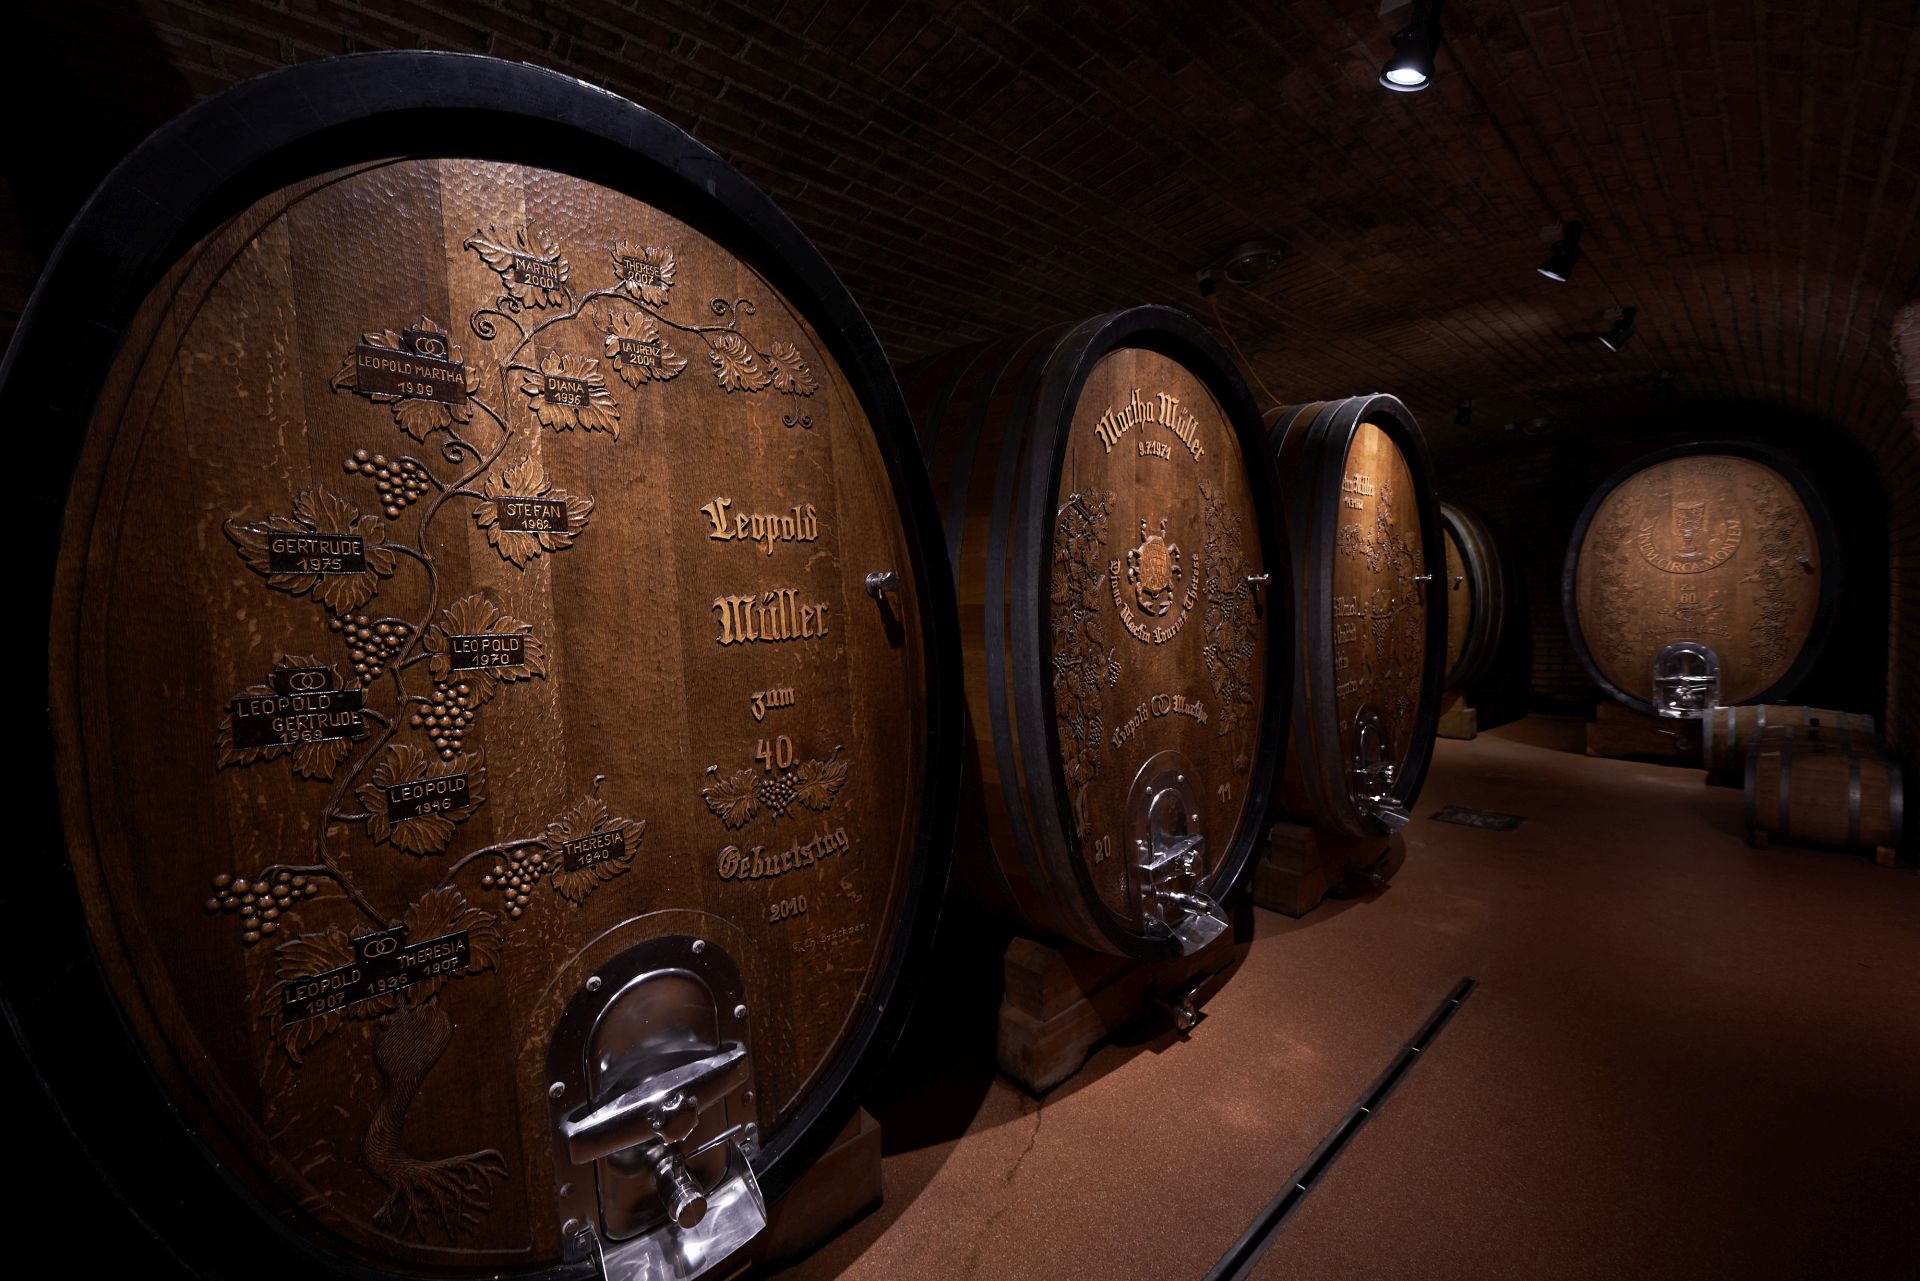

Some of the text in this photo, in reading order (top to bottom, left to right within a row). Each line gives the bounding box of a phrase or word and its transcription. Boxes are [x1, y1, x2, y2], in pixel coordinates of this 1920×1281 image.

[515, 258, 558, 279] MARTIN
[623, 258, 660, 276] THERESE
[627, 270, 655, 284] 2007
[523, 273, 554, 289] 2000
[622, 342, 662, 357] LAURENZ
[629, 353, 656, 366] 2004
[358, 354, 464, 384] LEOPOLD MARTHA
[397, 381, 434, 396] 1999
[548, 378, 584, 394] DIANA
[554, 391, 582, 405] 1996
[1094, 388, 1205, 463] Martha Müller
[506, 503, 562, 518] STEFAN
[521, 519, 552, 530] 1982
[700, 497, 819, 557] Leopold
[271, 538, 363, 555] GERTRUDE
[1637, 518, 1743, 572] VINUM CIRCA MONTEM
[296, 558, 343, 571] 1975
[712, 588, 830, 647] Müller
[453, 638, 520, 653] LEOPOLD
[470, 654, 511, 666] 1970
[237, 695, 332, 718] LEOPOLD
[750, 686, 796, 723] zum
[271, 711, 363, 732] GERTRUDE
[389, 778, 466, 804] LEOPOLD
[414, 798, 452, 814] 1946
[563, 832, 623, 856] THERESIA
[577, 849, 610, 865] 1940
[717, 826, 851, 883] Geburtstag
[769, 894, 808, 925] 2010
[398, 939, 466, 969] THERESIA
[422, 956, 460, 976] 1907
[284, 968, 362, 1005] LEOPOLD
[304, 991, 346, 1015] 1907
